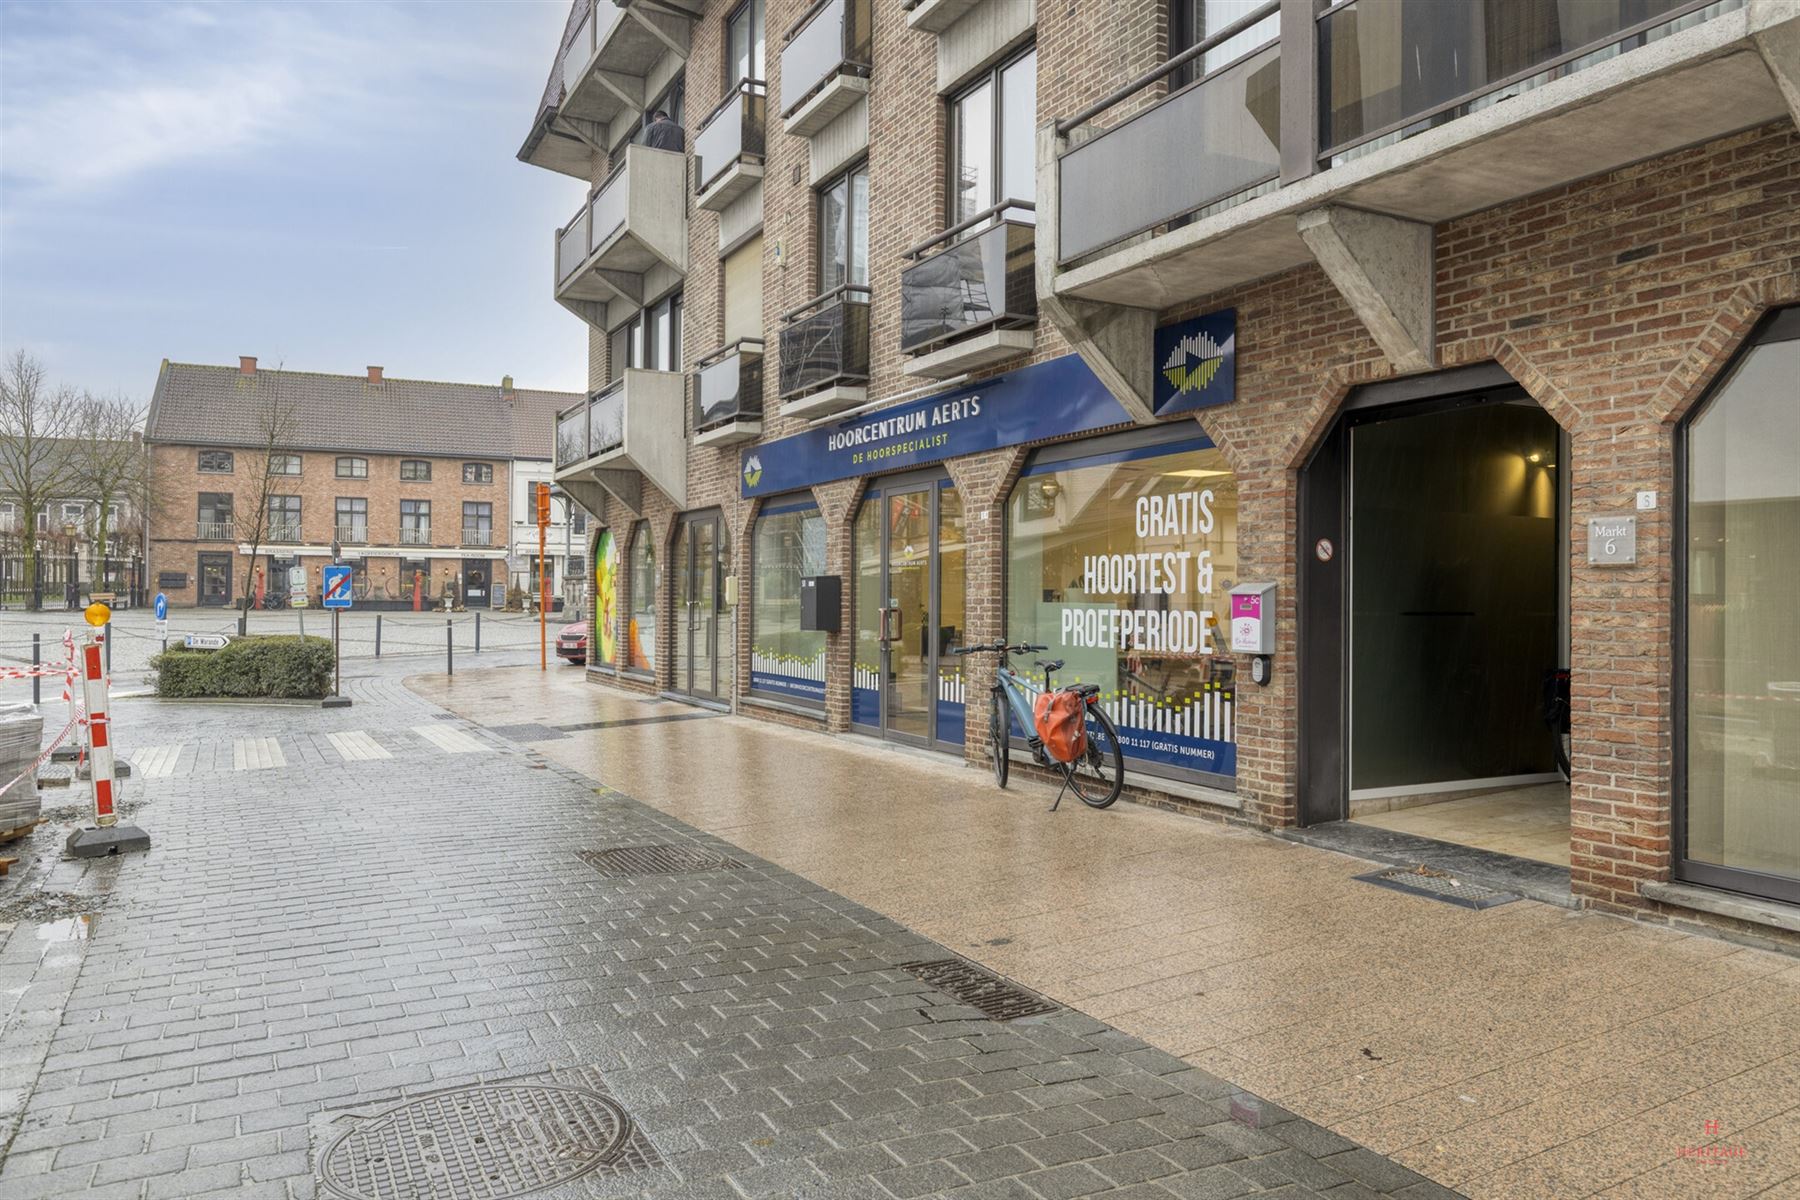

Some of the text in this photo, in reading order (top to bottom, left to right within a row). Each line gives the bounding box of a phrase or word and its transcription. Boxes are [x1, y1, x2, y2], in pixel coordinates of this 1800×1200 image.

[828, 395, 981, 452] HOORCENTRUM AERTS
[852, 433, 948, 465] DE HOORSPECIALIST
[1135, 489, 1214, 538] GRATIS
[1594, 525, 1627, 537] Markt
[1604, 538, 1616, 555] 6
[1083, 550, 1214, 595] HOORTEST &
[1061, 608, 1214, 655] PROEFPERIODE
[1115, 734, 1130, 745] 800
[1131, 738, 1138, 747] 11
[1139, 739, 1151, 749] 117
[1151, 740, 1179, 754] (GRATIS
[1179, 745, 1215, 760] NUMMER)
